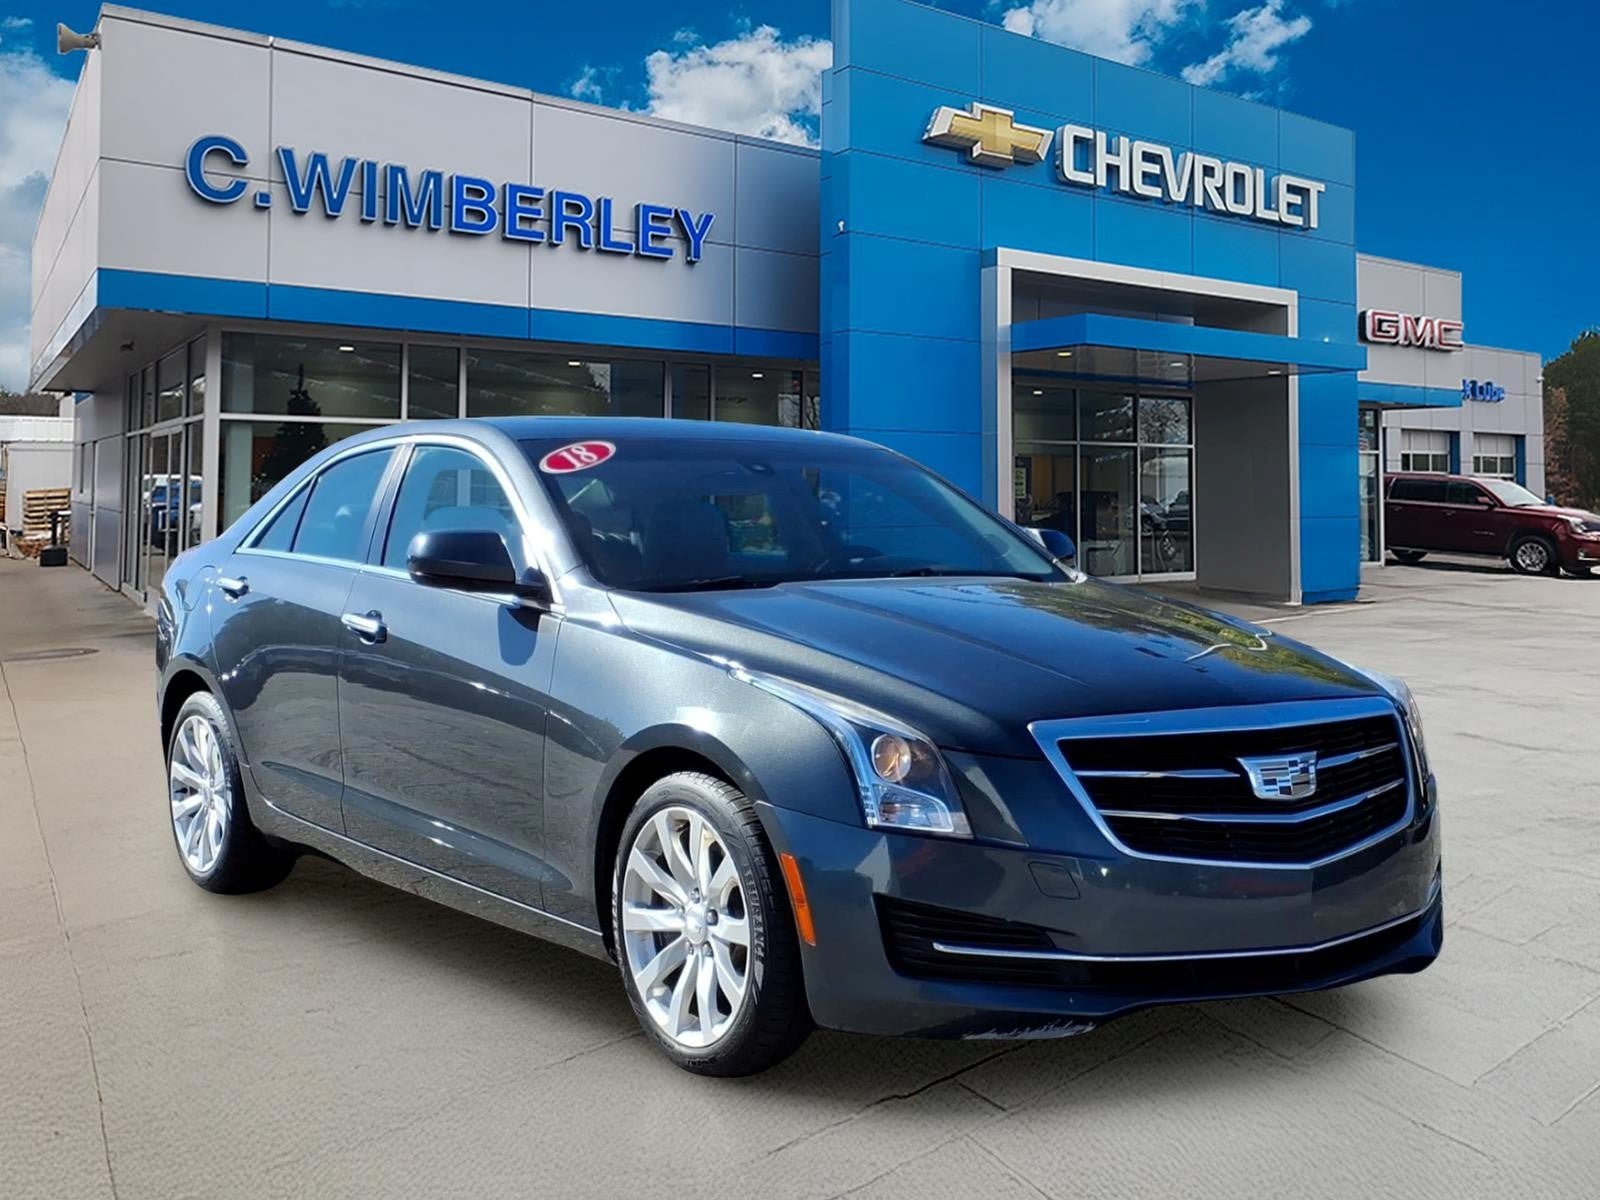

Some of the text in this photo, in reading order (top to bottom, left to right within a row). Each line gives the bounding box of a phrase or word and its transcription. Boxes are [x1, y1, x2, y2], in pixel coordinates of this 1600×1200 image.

[1055, 123, 1326, 230] CHEVROLET
[1359, 308, 1465, 352] GMC
[558, 445, 599, 468] 18
